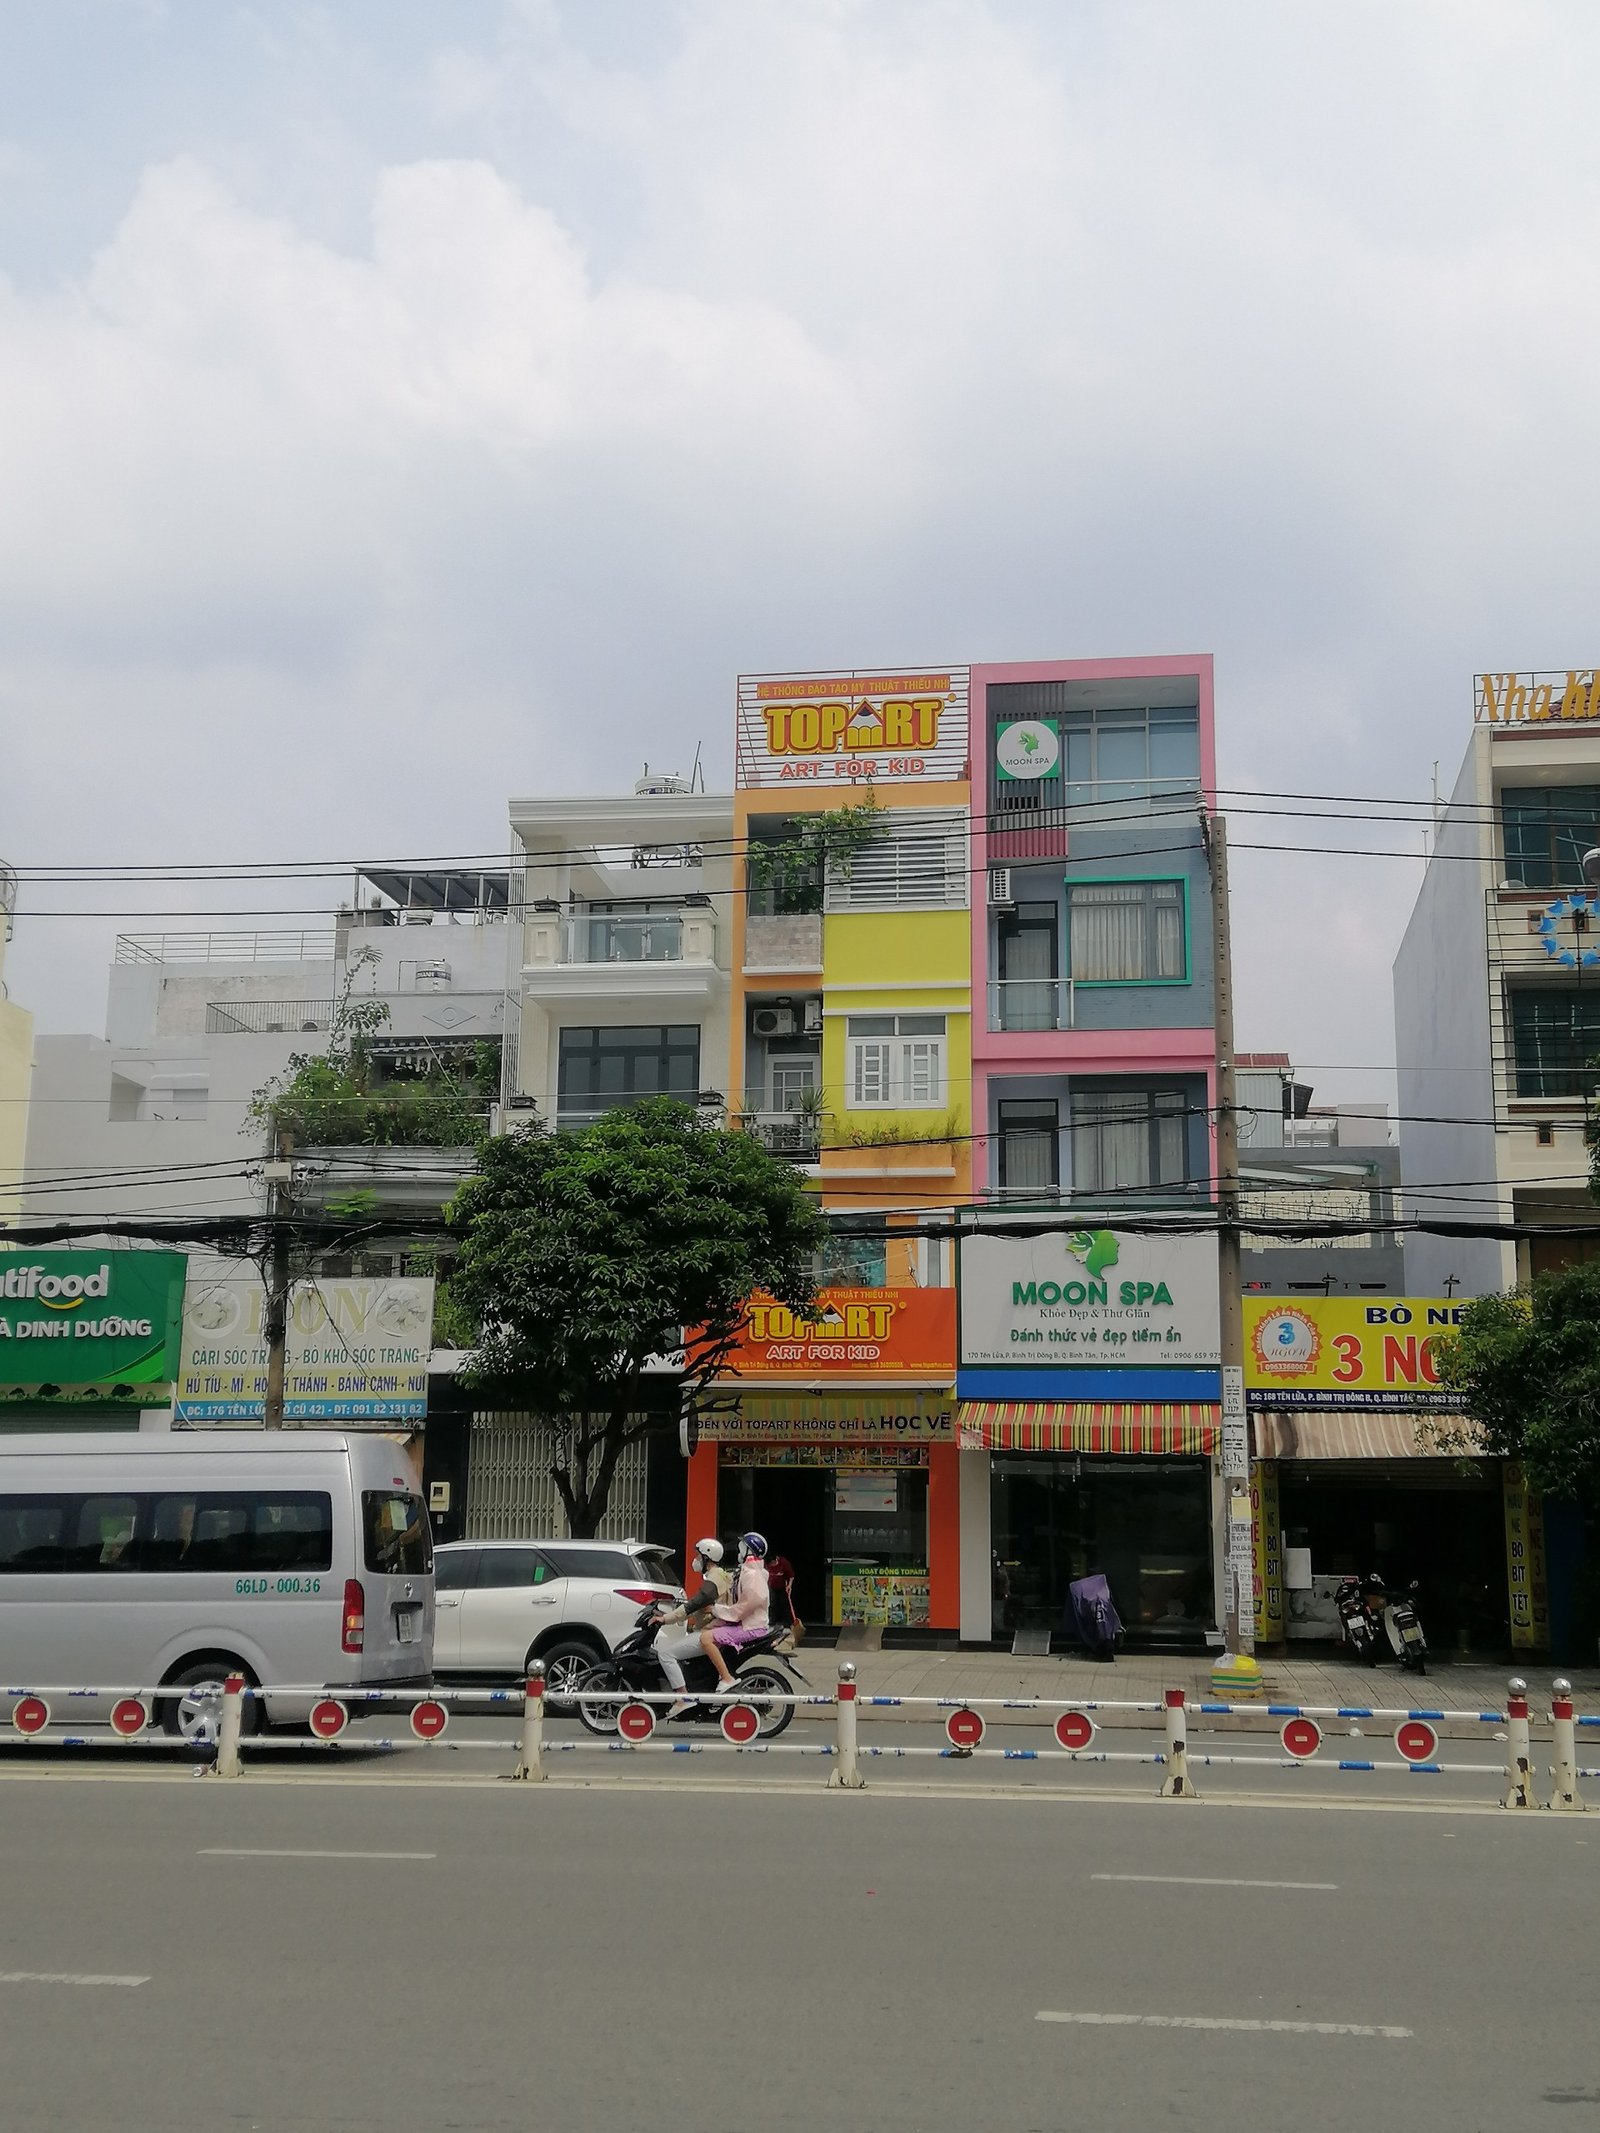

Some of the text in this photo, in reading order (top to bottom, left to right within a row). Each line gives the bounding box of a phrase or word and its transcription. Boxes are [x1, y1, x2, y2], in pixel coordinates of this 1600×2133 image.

[780, 758, 926, 778] ART FOR KID
[1005, 757, 1050, 766] MOON SPA
[0, 1264, 109, 1298] tifood
[1012, 1281, 1174, 1305] MOON SPA
[1040, 1308, 1066, 1319] Khỏe
[1069, 1309, 1089, 1320] Đẹp
[1090, 1309, 1099, 1318] &
[1102, 1309, 1123, 1318] Thư
[1366, 1303, 1412, 1324] BÒ
[16, 1320, 70, 1338] DINH
[74, 1315, 152, 1338] DƯỠNG
[1011, 1327, 1043, 1342] Đánh
[1048, 1327, 1077, 1342] thức
[1080, 1327, 1098, 1342] vẻ
[1102, 1327, 1127, 1346] đẹp
[1132, 1327, 1162, 1342] tiềm
[1278, 1322, 1295, 1345] 3
[192, 1345, 220, 1366] CÀRI
[223, 1345, 248, 1365] SÓC
[303, 1344, 319, 1364] BÒ
[324, 1348, 348, 1364] KHO
[352, 1344, 376, 1364] SÓC
[766, 1345, 881, 1360] ART FOR KID
[1331, 1333, 1364, 1384] 3
[186, 1371, 200, 1393] HỦ
[231, 1373, 244, 1393] MÌ
[293, 1372, 328, 1392] THÁNH
[338, 1372, 367, 1392] BÁNH
[206, 1405, 224, 1415] 176
[352, 1404, 370, 1414] 091
[722, 1417, 743, 1429] VỚI
[746, 1420, 791, 1429] TOPART
[793, 1417, 836, 1430] KHÔNG
[880, 1415, 921, 1434] HỌC
[926, 1411, 951, 1430] VẼ
[235, 1578, 268, 1594] 66LD
[277, 1577, 321, 1593] 000.36
